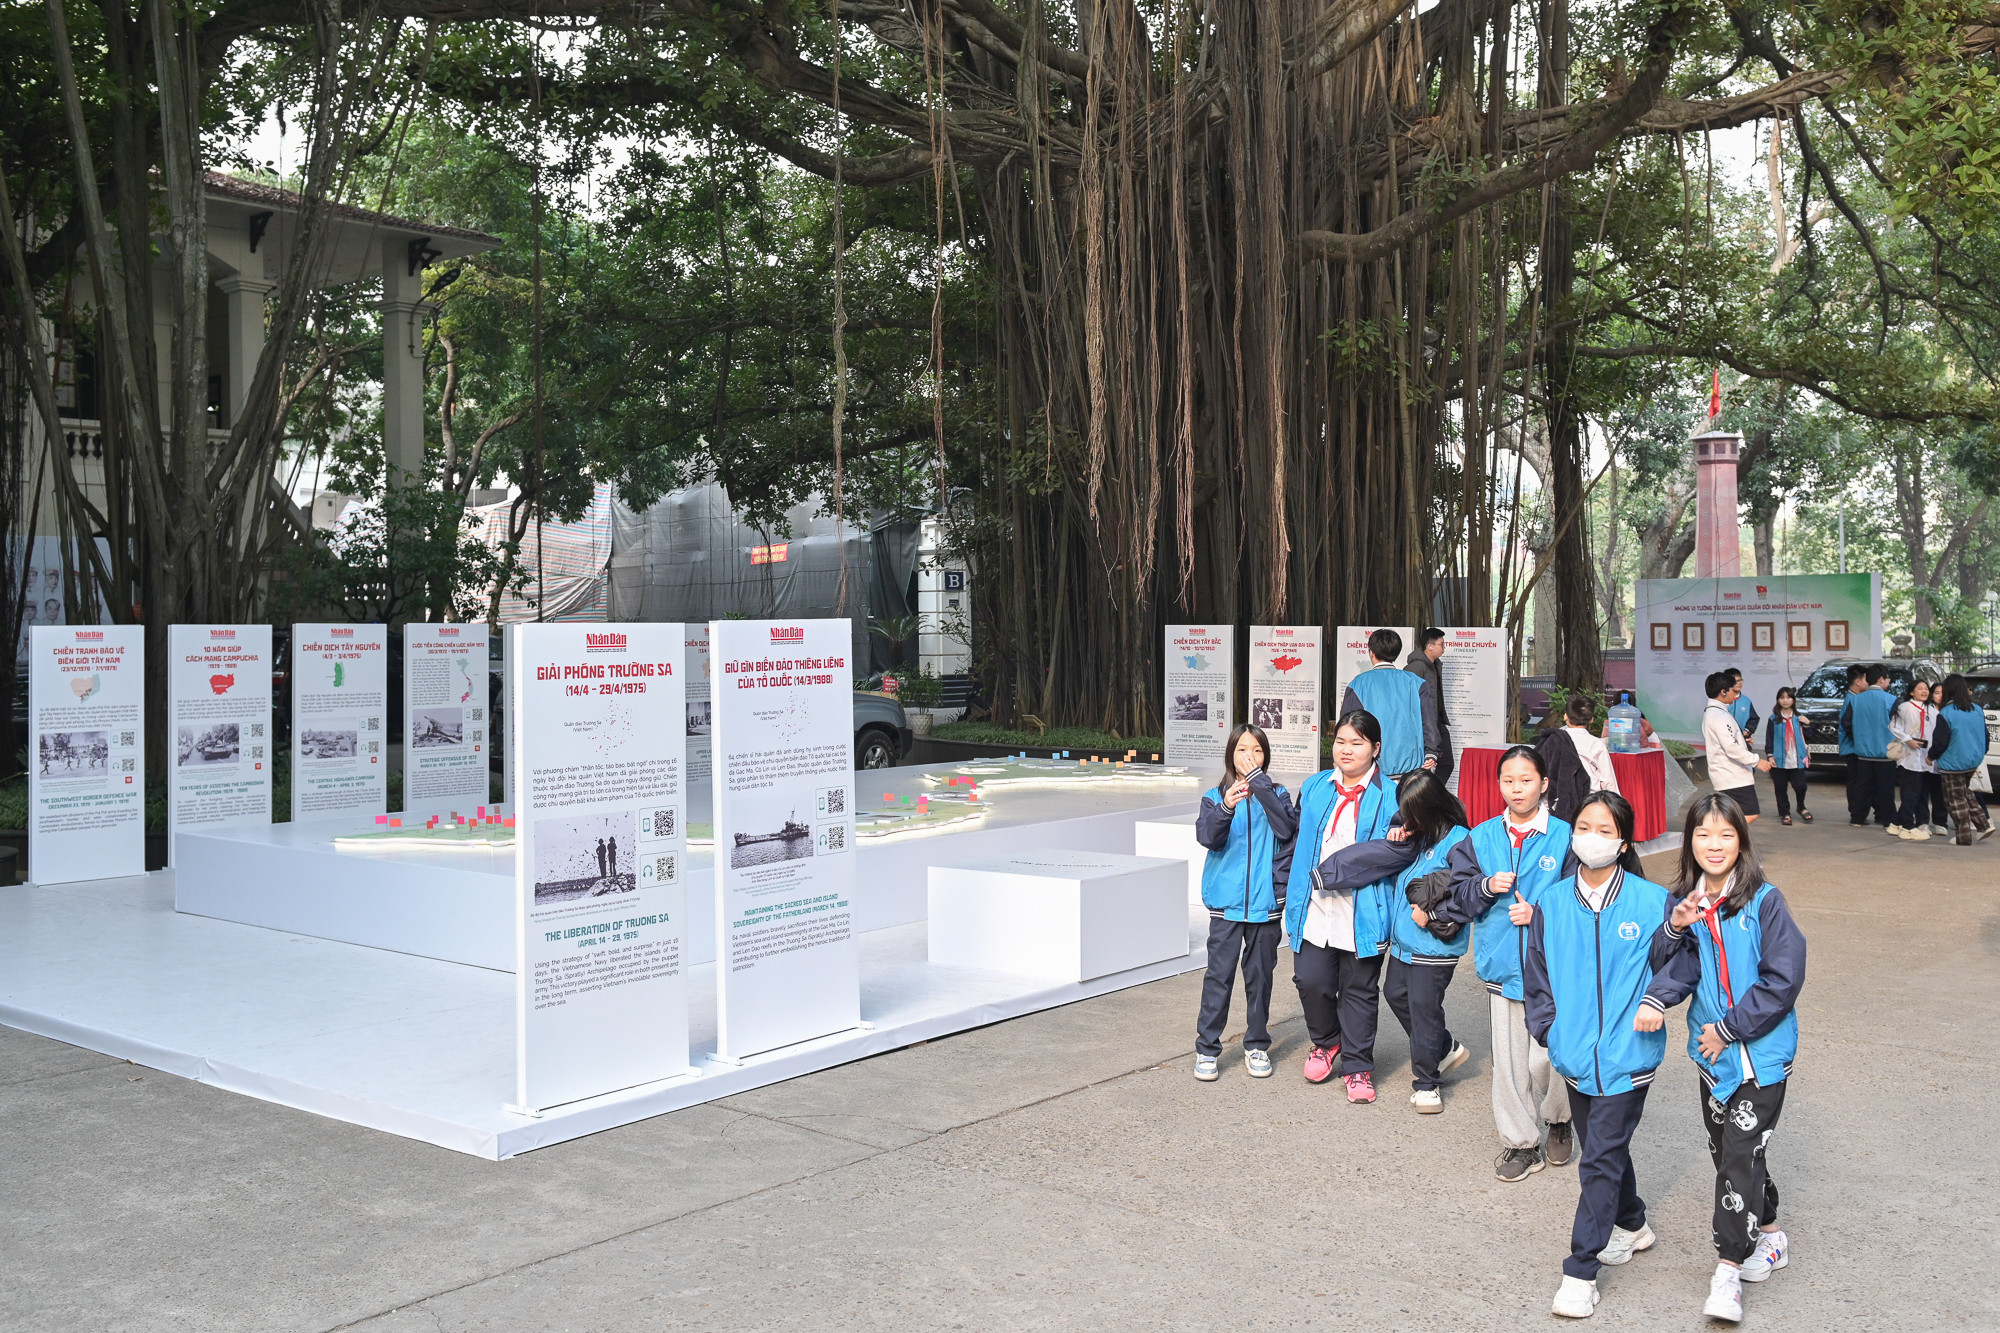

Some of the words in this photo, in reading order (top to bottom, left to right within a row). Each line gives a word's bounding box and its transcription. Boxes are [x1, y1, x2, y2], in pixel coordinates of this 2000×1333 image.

[948, 574, 960, 588] B
[53, 646, 74, 655] CHIẾN
[116, 646, 125, 655] VỆ
[302, 642, 322, 652] CHIẾN
[341, 643, 354, 651] TÂY
[355, 642, 381, 651] NGUYÊN
[58, 656, 74, 665] BIÊN
[725, 660, 739, 673] GIỮ
[740, 660, 754, 672] GÌN
[756, 656, 774, 672] BIỂN
[776, 658, 793, 671] ĐẢO
[794, 657, 822, 670] THIÊNG
[823, 656, 844, 668] LIÊNG
[537, 662, 561, 680] GIẢI
[564, 662, 605, 679] PHÓNG
[608, 662, 654, 678] TRƯỜNG
[657, 663, 673, 676] SA
[565, 684, 589, 696] (14/4
[599, 682, 647, 695] 29/4/1975)
[738, 676, 755, 689] CỦA
[756, 672, 768, 688] TỔ
[770, 672, 792, 687] QUỐC
[794, 674, 833, 686] (14/3/1988)
[744, 905, 774, 917] MAINTAINING
[784, 900, 802, 909] SACRED
[812, 896, 823, 904] AND
[823, 893, 838, 902] ISLAND
[733, 916, 765, 928] SOVEREIGNTY
[773, 912, 782, 920] THE
[782, 907, 812, 918] FATHERLAND
[812, 903, 829, 913] (MARCH
[545, 931, 562, 942] THE
[563, 922, 611, 939] LIBERATION
[612, 921, 623, 931] OF
[625, 915, 657, 929] TRUONG
[658, 913, 669, 923] SA
[578, 937, 598, 948] (APRIL
[623, 930, 639, 940] 1975)
[562, 962, 592, 971] Vietnamese
[610, 954, 632, 963] liberated
[586, 965, 617, 975] Archipelago
[618, 960, 641, 969] occupied
[661, 953, 679, 962] puppet
[577, 977, 595, 986] played
[600, 971, 624, 982] significant
[651, 962, 669, 972] present
[579, 984, 602, 993] asserting
[627, 974, 651, 983] inviolable
[652, 969, 679, 979] sovereignty
